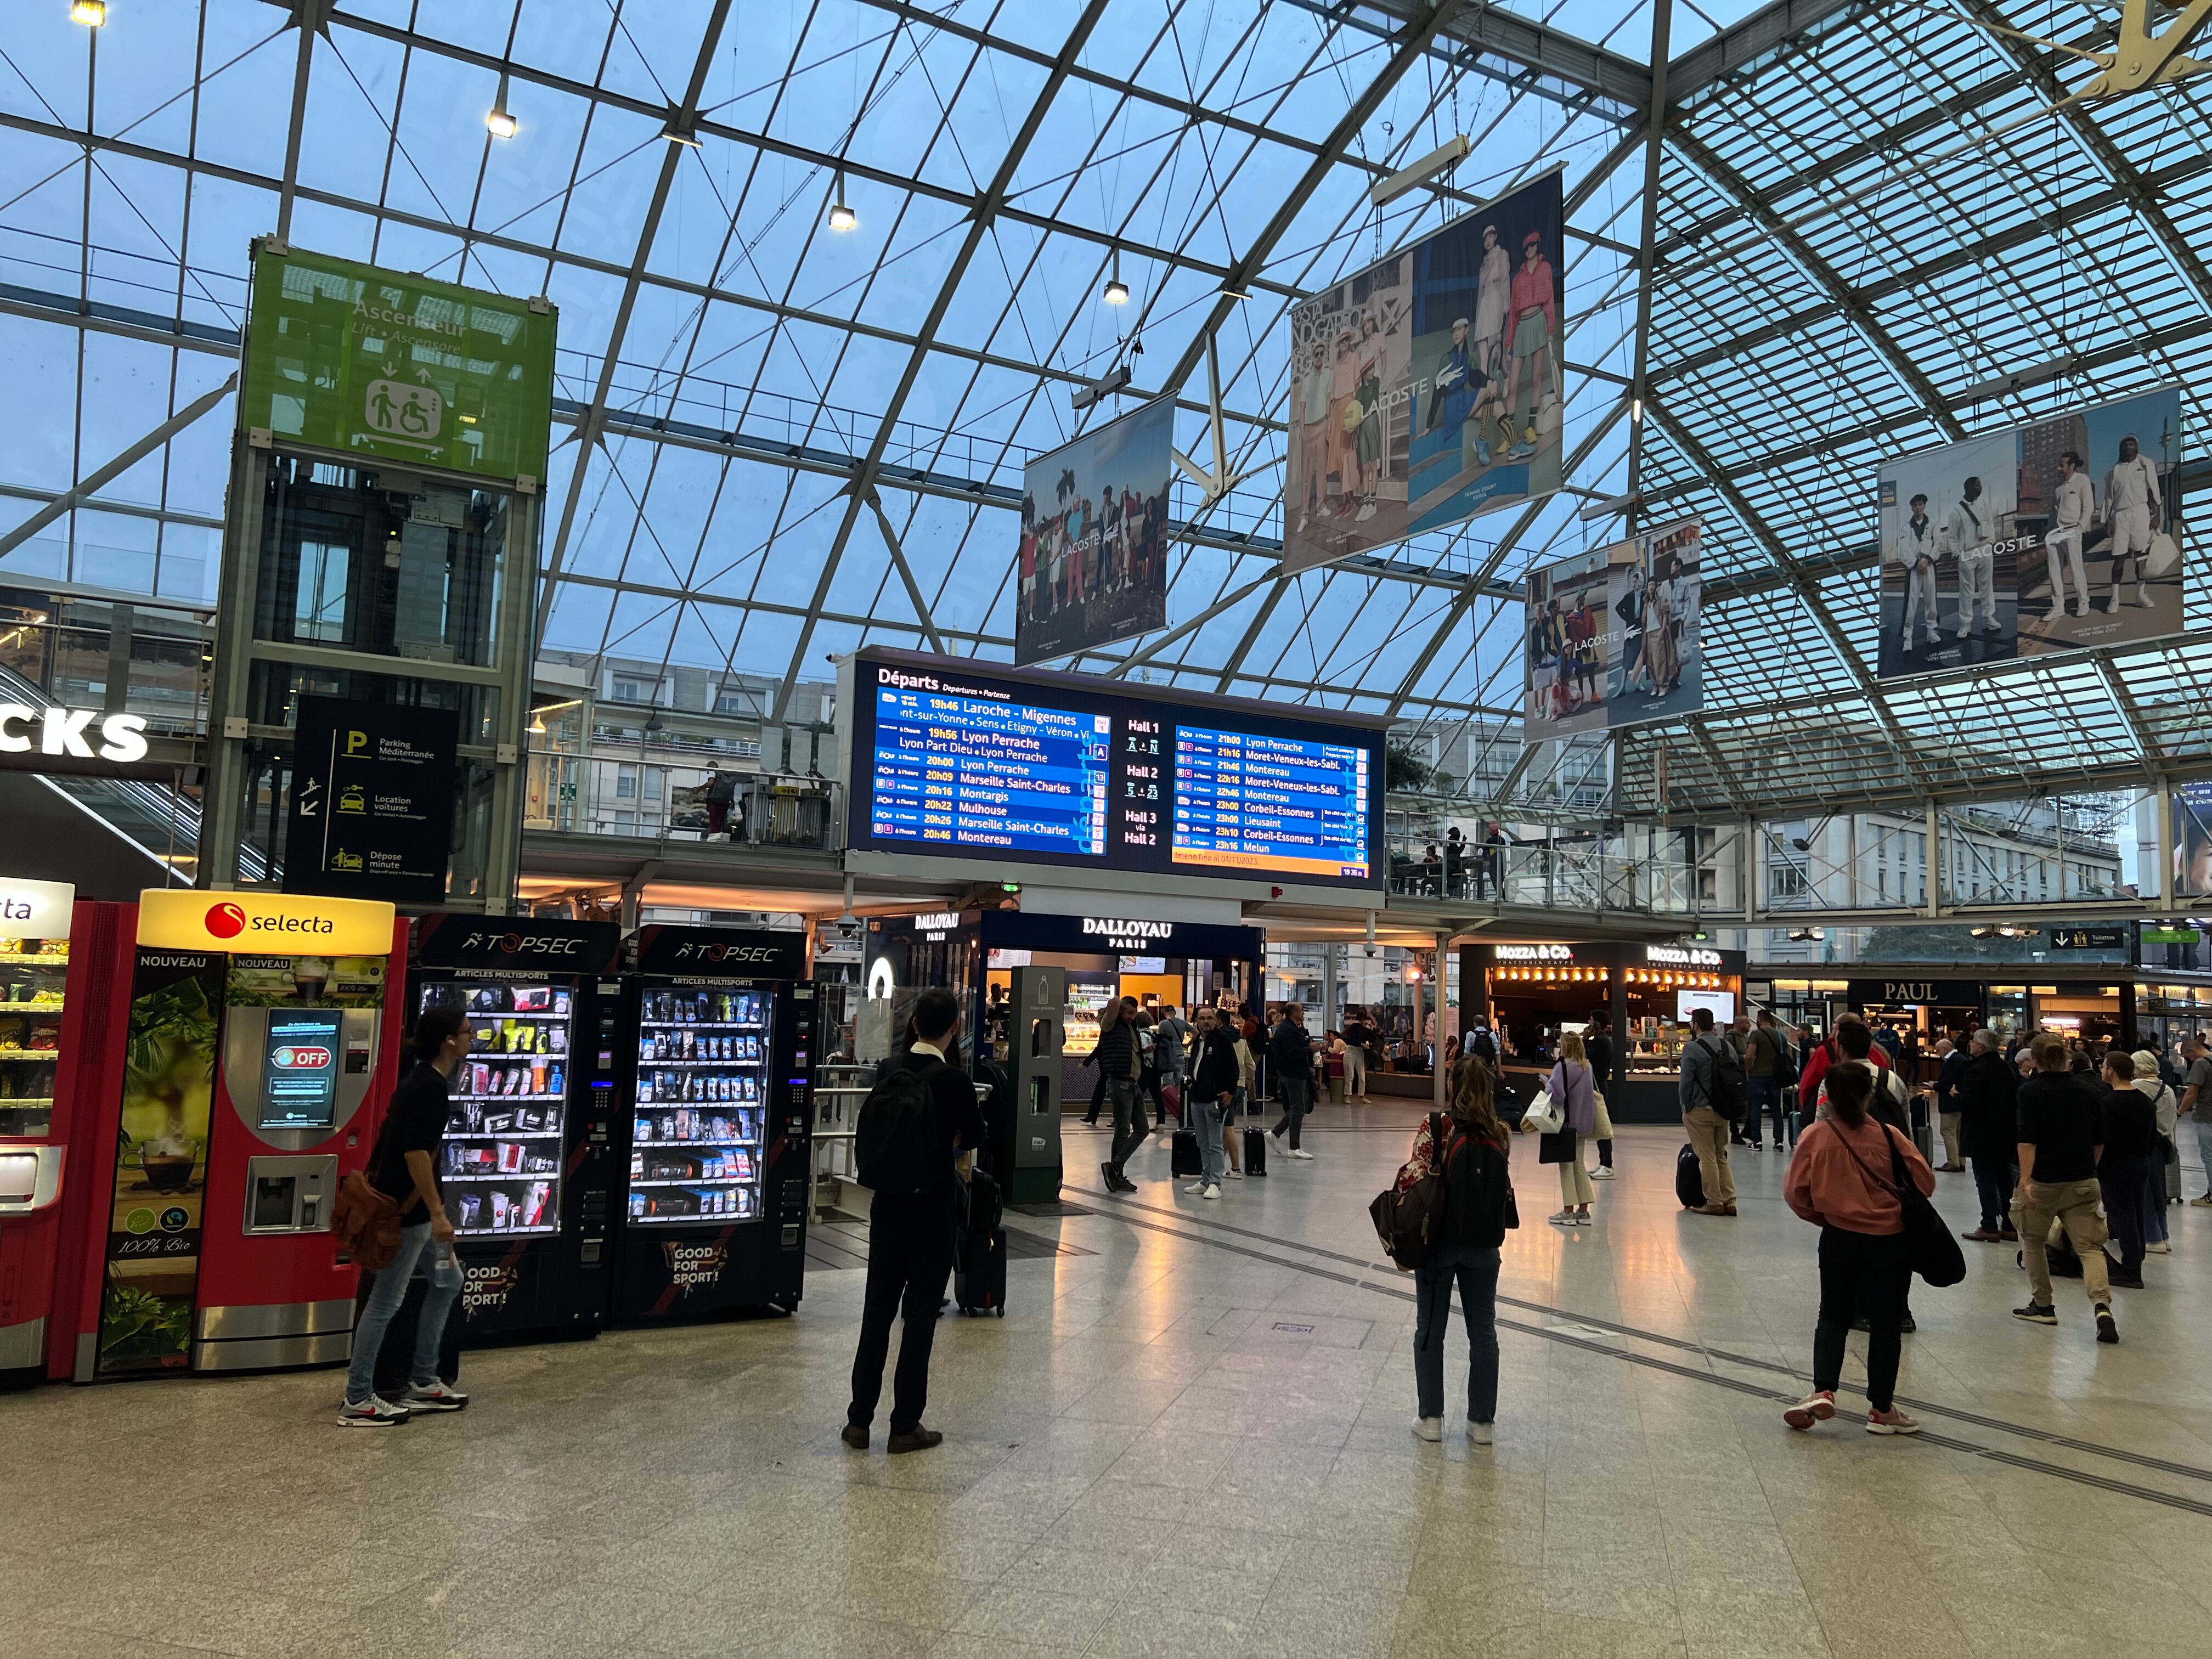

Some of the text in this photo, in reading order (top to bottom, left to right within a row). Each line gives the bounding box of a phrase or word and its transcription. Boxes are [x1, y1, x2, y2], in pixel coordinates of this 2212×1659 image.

[352, 300, 468, 338] Ascenseur
[351, 322, 461, 355] Lift Ascensore
[1361, 378, 1429, 419] LACOSTE
[1464, 483, 1497, 498] TENNIS COURT
[1472, 492, 1487, 501] SEOUL
[1061, 534, 1100, 558] LACOSTE
[1961, 534, 2036, 562] LACOSTE
[1575, 631, 1620, 652] LACOSTE
[878, 668, 939, 690] Départs
[943, 684, 1011, 699] Departures Partenze
[929, 699, 1077, 726] 19h46 Laroche Migennes
[976, 717, 999, 729] Sens
[1007, 721, 1037, 736] Etigny
[1046, 725, 1073, 738] Véron
[1128, 719, 1159, 733] Hall 1
[347, 730, 368, 753] P
[380, 738, 411, 750] Parking
[928, 727, 957, 740] 19h56
[962, 730, 989, 744] Lyon
[992, 733, 1040, 749] Perrache
[1098, 748, 1104, 757] A
[1128, 741, 1136, 751] A
[1150, 744, 1158, 753] N
[1218, 734, 1303, 753] 21h00 Lyon Perrache
[379, 747, 435, 759] Méditerranée
[899, 737, 1048, 763] Lyon Part Dieu Lyon Perrache
[926, 756, 954, 767] 20h00
[961, 759, 984, 771] Lyon
[987, 761, 1030, 776] Perrache
[1217, 747, 1340, 770] 21h16 Moret-Veneux-les-Sabl.
[1127, 764, 1158, 779] Hall 2
[1217, 760, 1290, 777] 21h46 Montereau
[926, 770, 953, 782] 20h09
[960, 773, 1005, 788] Marseille
[1007, 777, 1071, 794] Saint-Charles
[1217, 774, 1340, 795] 22h16 Moret-Veneux-les-Sabl.
[375, 795, 411, 805] Location
[925, 785, 953, 796] 20h16
[960, 787, 1009, 803] Montargis
[1127, 786, 1158, 798] 5 23
[1216, 787, 1289, 803] 22h46 Montereau
[374, 803, 408, 812] voitures
[924, 800, 952, 811] 20h22
[959, 802, 1007, 816] Mulhouse
[1216, 801, 1314, 819] 23h00 Corbeil-Essonnes
[924, 814, 952, 825] 20h26
[958, 816, 1003, 830] Marseille
[1005, 820, 1069, 836] Saint-Charles
[1125, 810, 1157, 824] Hall 3
[1216, 814, 1281, 828] 23h00 Lieusaint
[1135, 823, 1146, 832] via
[923, 829, 1012, 845] 20h46 Montereau
[1124, 832, 1156, 845] Hall 2
[1215, 827, 1314, 845] 23h10 Corbeil-Essonnes
[1215, 840, 1270, 853] 23h16 Melun
[370, 851, 402, 861] Dépose
[1198, 853, 1212, 861] fino
[1221, 855, 1260, 865] 01/11/2023.
[370, 860, 400, 869] minute
[250, 915, 334, 934] selecta
[915, 913, 960, 929] DALLOYAU
[1082, 918, 1172, 938] DALLOYAU
[488, 933, 583, 954] TOPSEC
[926, 932, 946, 941] PARIS
[1109, 938, 1147, 949] PARIS
[697, 943, 778, 962] TOPSEC
[1538, 945, 1549, 960] &
[1690, 949, 1701, 964] &
[140, 956, 206, 968] NOUVEAU
[238, 960, 289, 969] NOUVEAU
[454, 970, 549, 980] ARTICLES MULTISPORTS
[707, 978, 753, 986] MULTISPORTS
[1884, 983, 1938, 1001] PAUL
[297, 1052, 328, 1065] OFF
[117, 1238, 190, 1254] 100% Bio
[674, 1247, 713, 1259] GOOD
[467, 1267, 501, 1279] OOD
[674, 1260, 698, 1272] FOR
